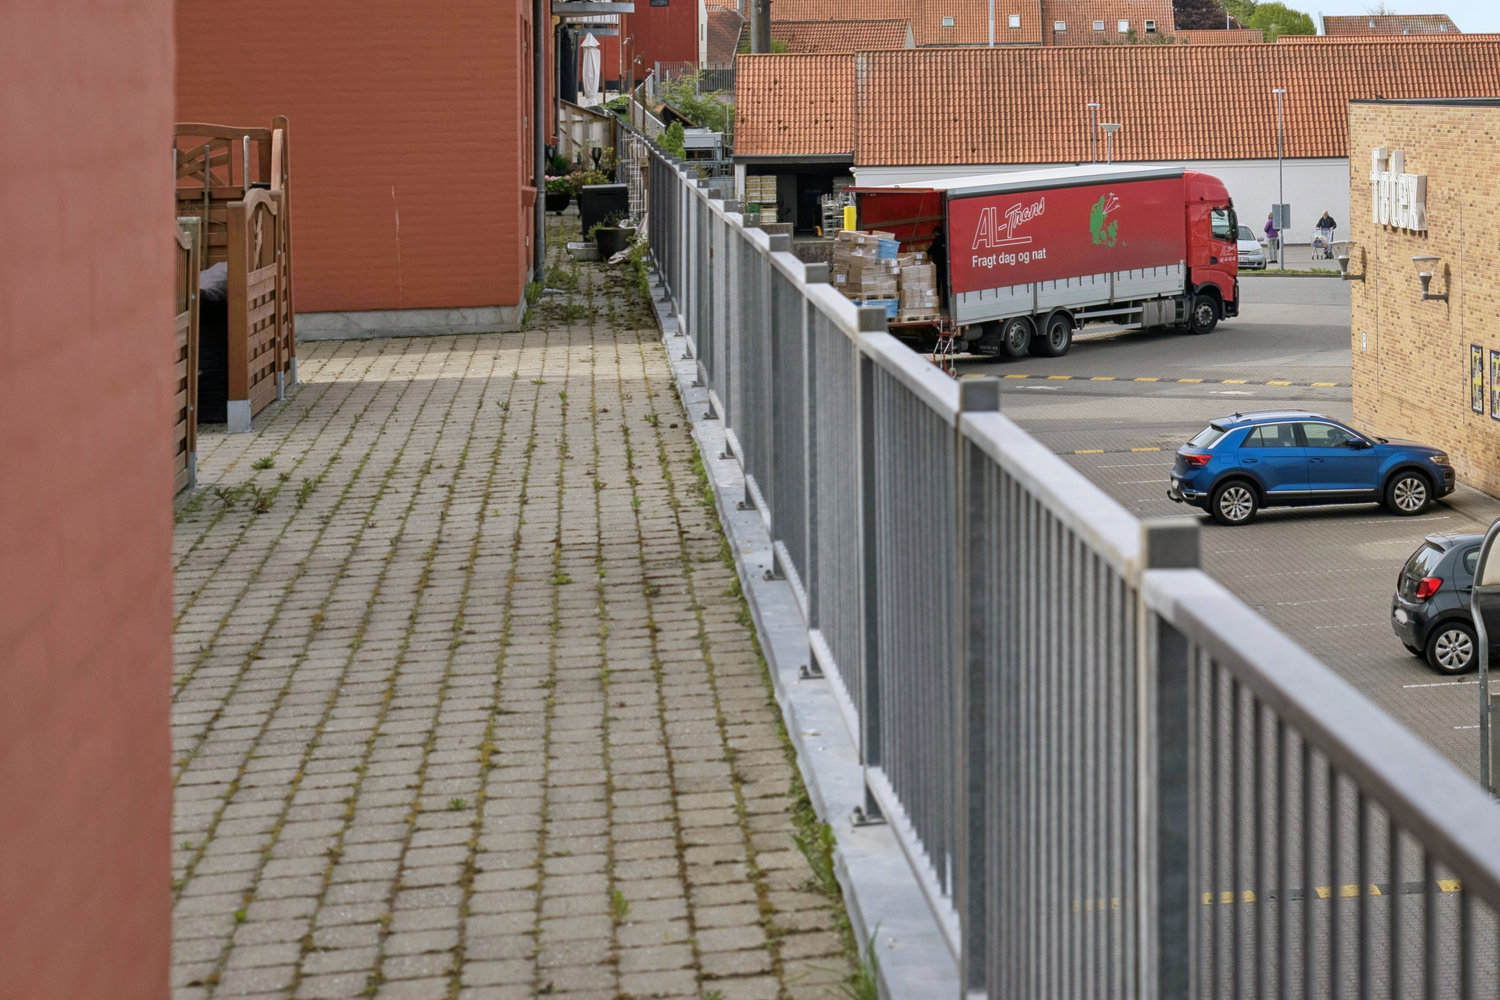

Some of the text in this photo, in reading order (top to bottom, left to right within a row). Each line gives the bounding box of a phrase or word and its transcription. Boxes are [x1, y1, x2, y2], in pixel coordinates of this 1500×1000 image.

[972, 247, 1047, 269] Fragt dag og nat
